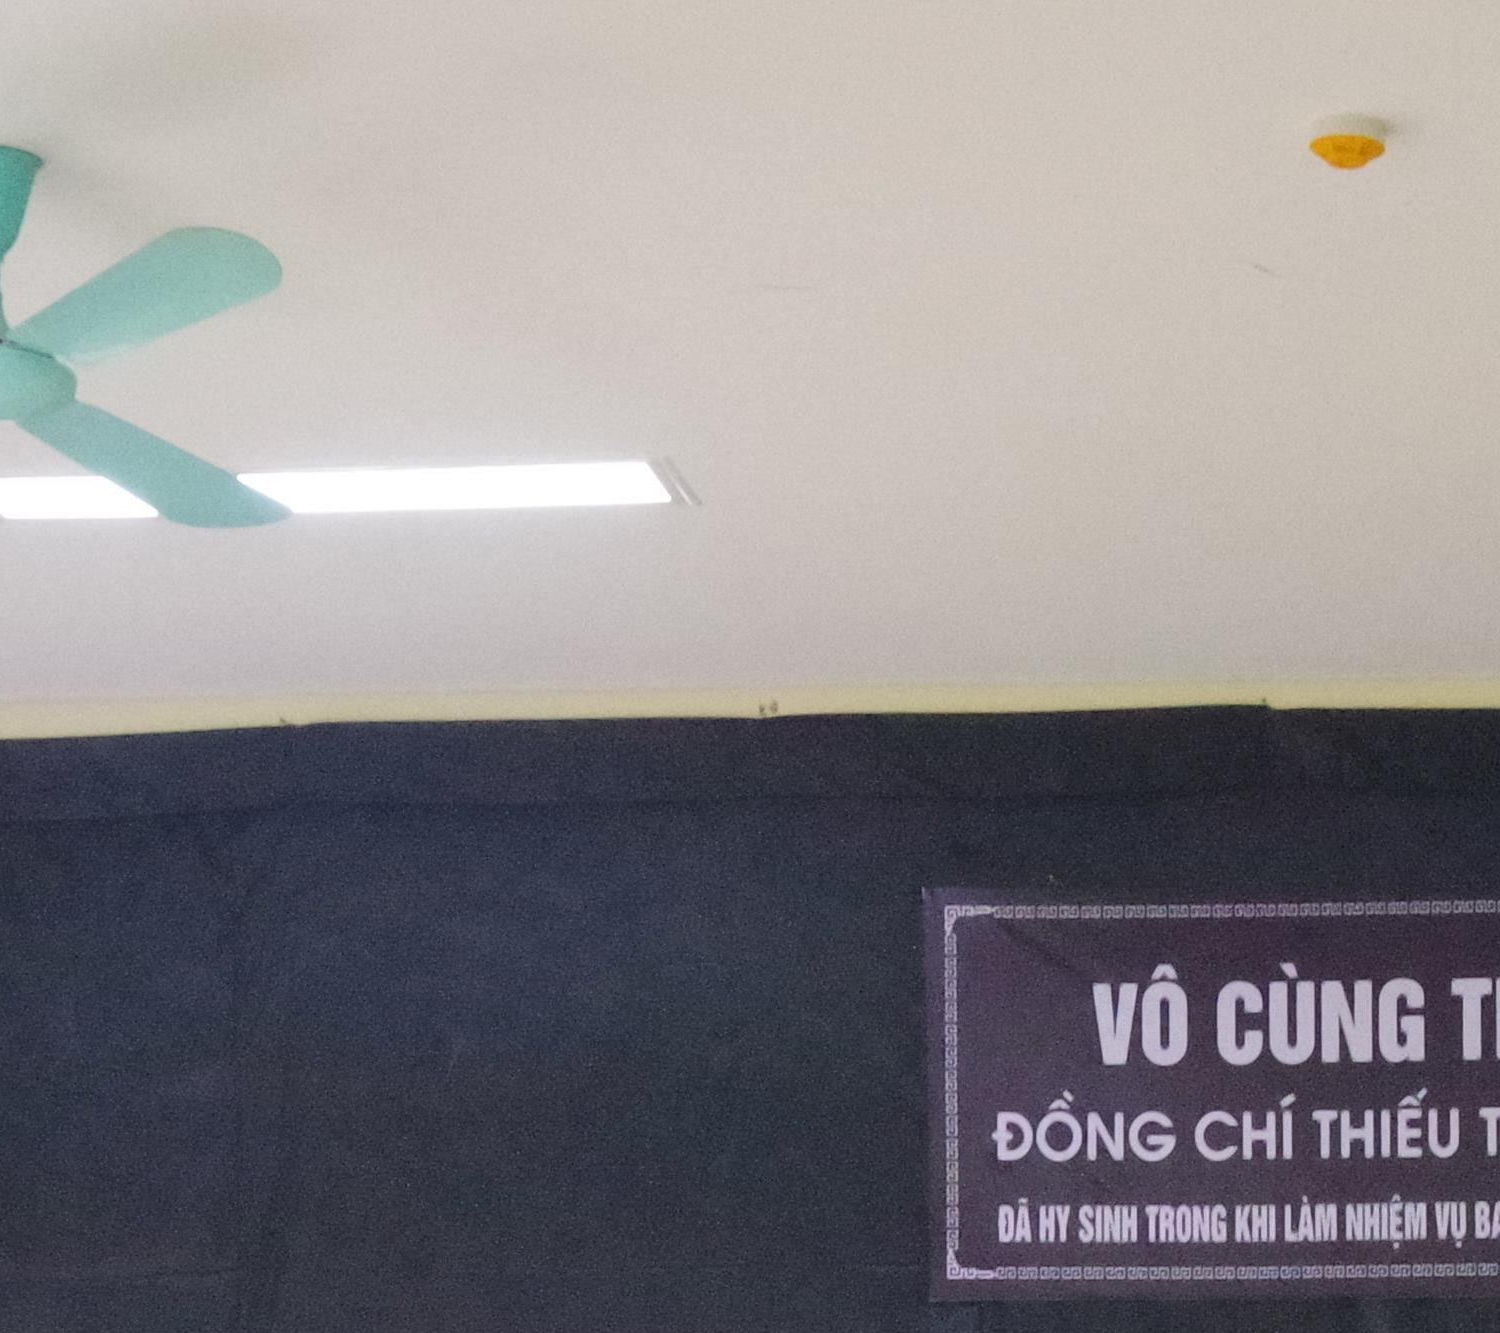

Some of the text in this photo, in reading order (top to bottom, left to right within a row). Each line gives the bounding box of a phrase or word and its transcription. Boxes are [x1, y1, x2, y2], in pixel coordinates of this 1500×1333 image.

[1092, 963, 1189, 1066] VÔ
[1216, 962, 1426, 1066] CÙNG
[991, 1088, 1177, 1163] ĐỒNG
[1194, 1092, 1296, 1162] CHÍ
[1311, 1085, 1460, 1160] THIẾU
[997, 1197, 1032, 1244] ĐÃ
[1038, 1204, 1071, 1244] HY
[1078, 1204, 1138, 1244] SINH
[1144, 1203, 1228, 1244] TRONG
[1234, 1203, 1277, 1243] KHI
[1284, 1195, 1338, 1243] LÀM
[1345, 1193, 1428, 1249] NHIỆM
[1434, 1201, 1467, 1248] VỤ
